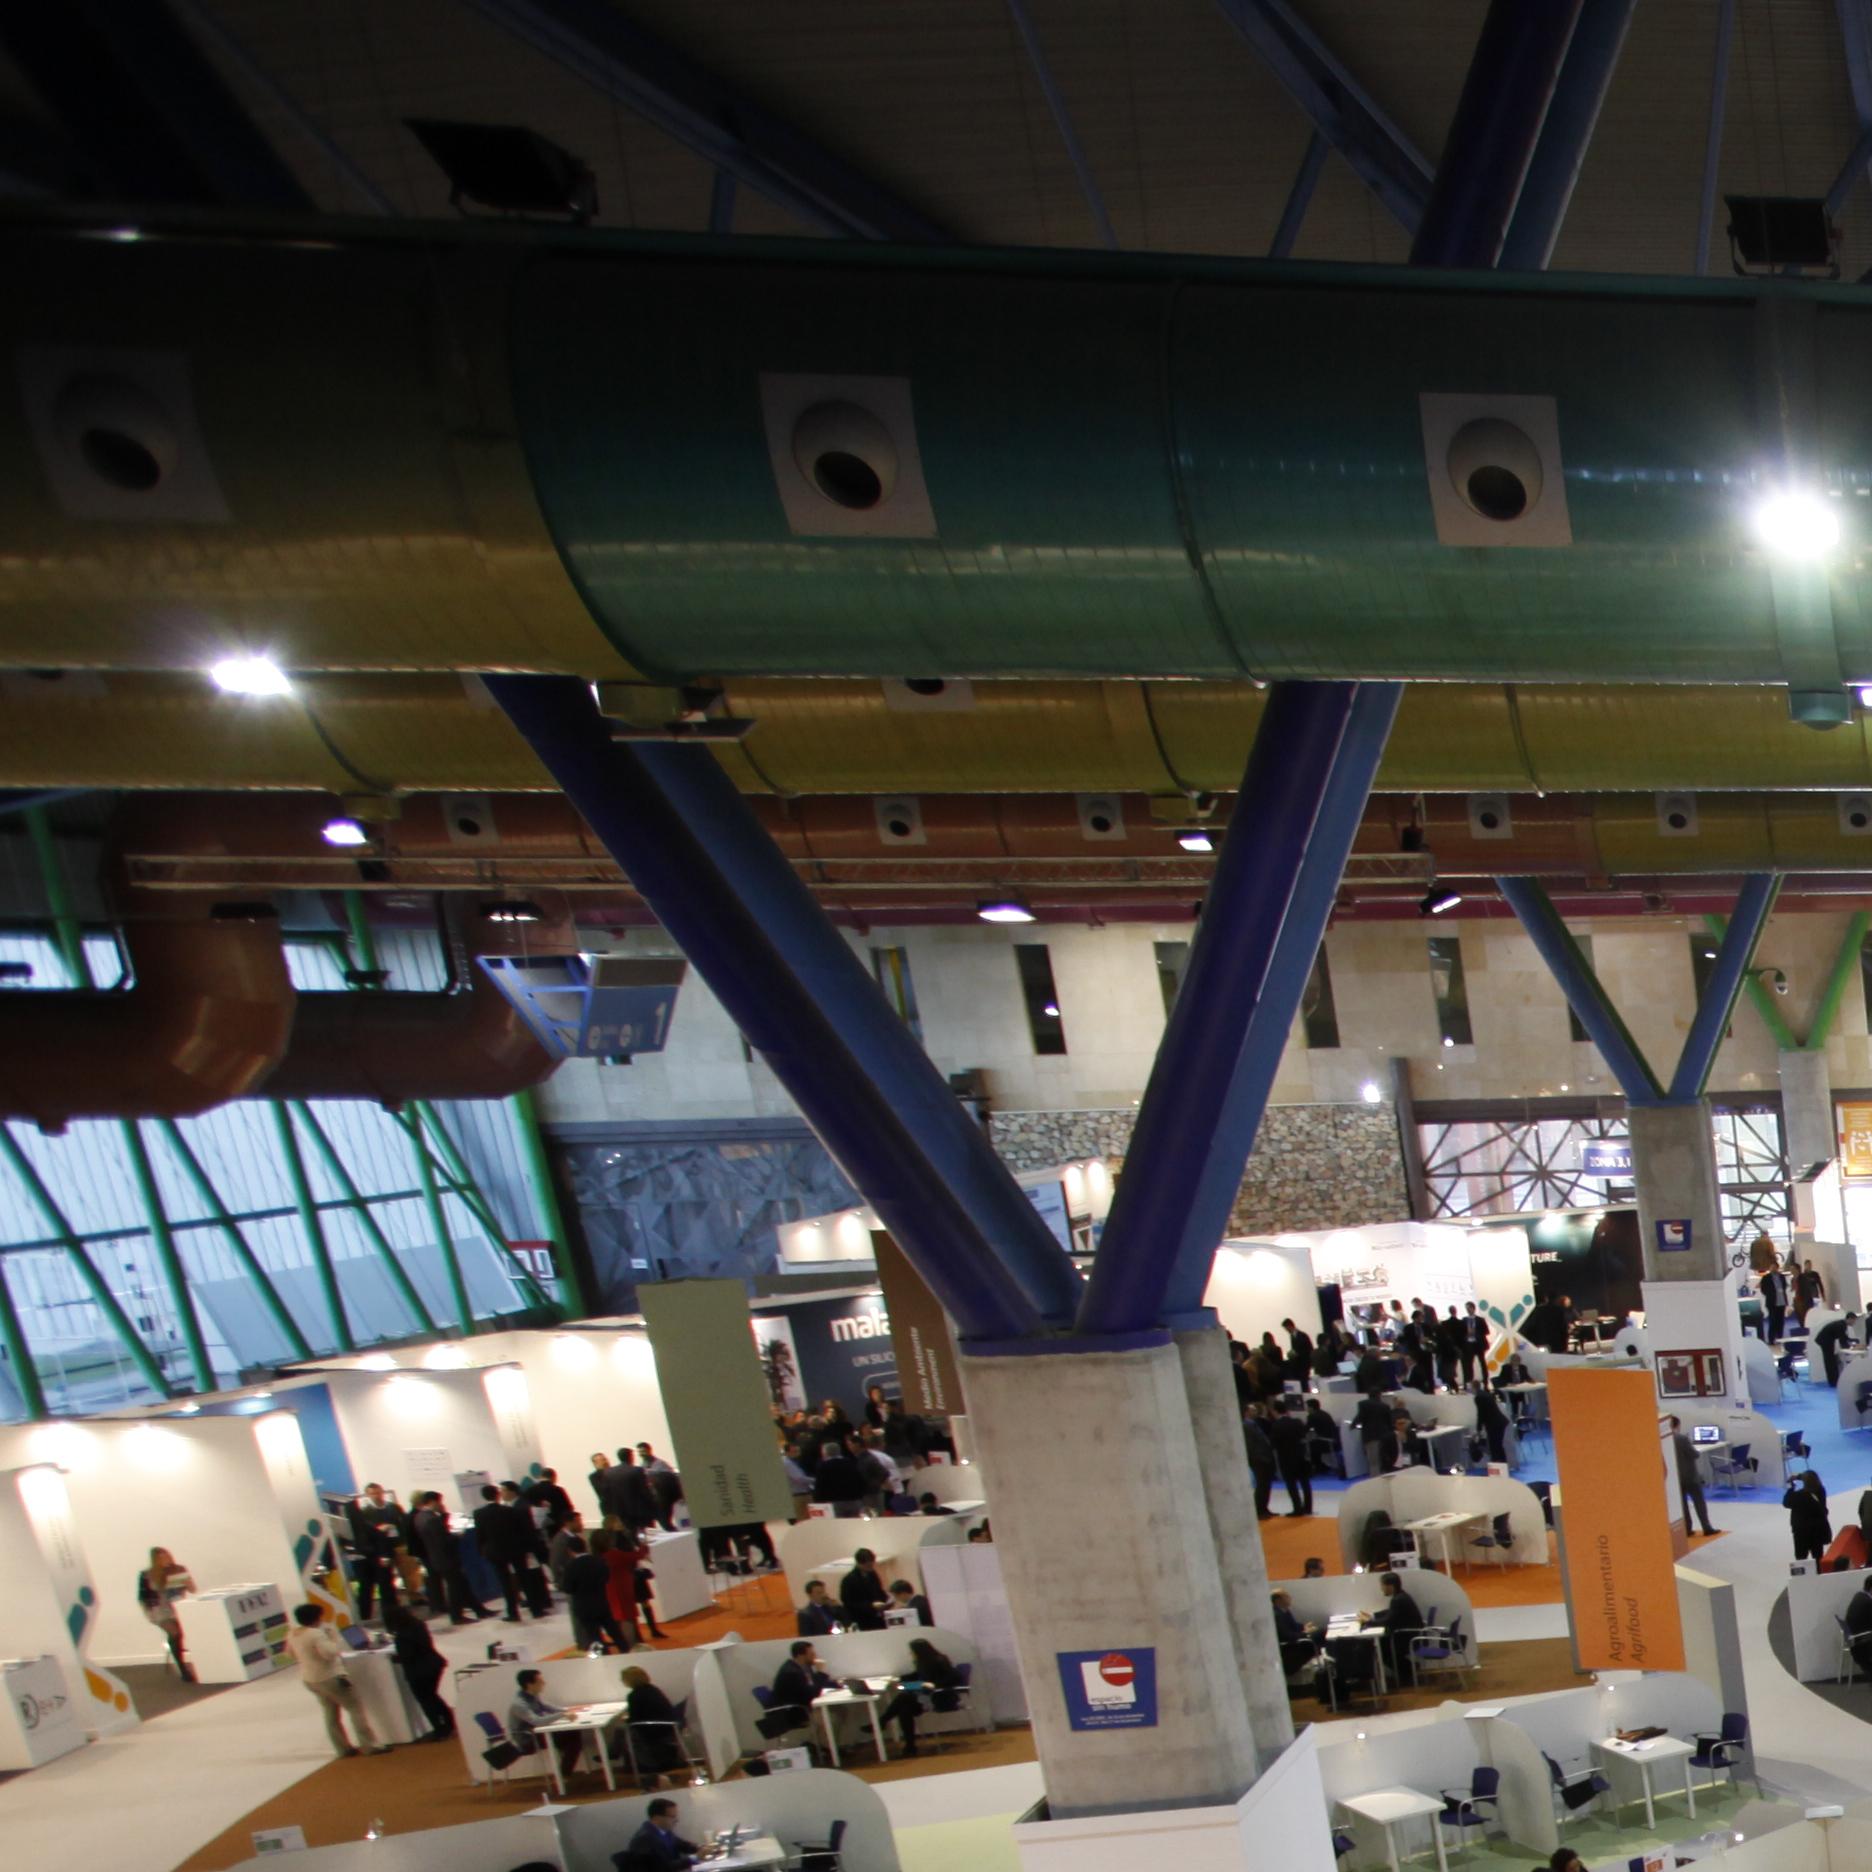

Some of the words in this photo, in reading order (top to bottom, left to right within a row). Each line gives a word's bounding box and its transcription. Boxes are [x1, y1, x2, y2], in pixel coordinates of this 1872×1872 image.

[910, 1326, 927, 1376] Ambiente
[920, 1377, 933, 1410] Medio
[709, 1465, 735, 1517] Sanidad
[736, 1473, 757, 1513] Health
[1596, 1534, 1625, 1663] Agroalimentario
[1623, 1596, 1647, 1664] Agrifood
